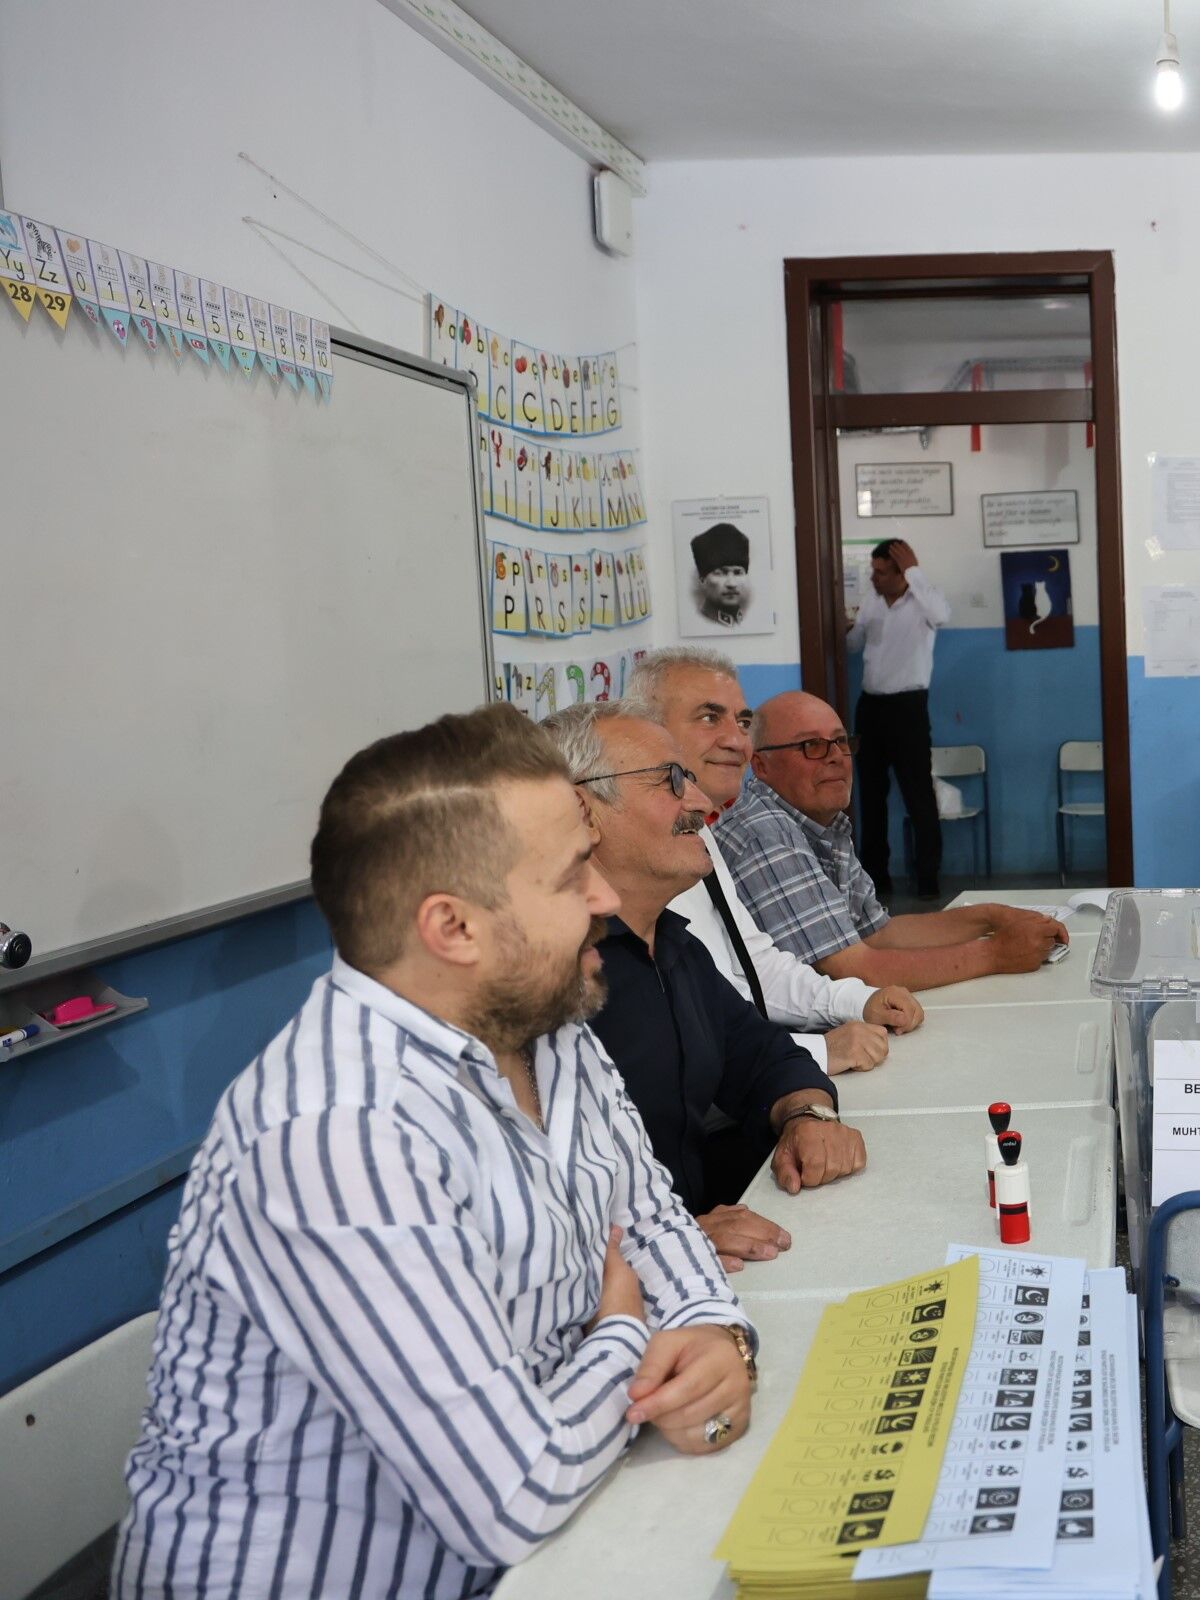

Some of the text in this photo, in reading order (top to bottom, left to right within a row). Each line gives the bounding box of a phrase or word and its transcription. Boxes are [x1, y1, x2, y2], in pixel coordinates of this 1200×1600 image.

[9, 282, 66, 312] 28 29
[36, 258, 58, 283] Zz
[108, 281, 116, 301] 1
[136, 290, 146, 310] 2
[160, 299, 170, 318] 3
[186, 308, 195, 326] 4
[211, 315, 221, 334] 5
[236, 324, 244, 341] 6
[258, 331, 266, 347] 7
[280, 338, 287, 355] 8
[299, 345, 306, 361] 9
[317, 351, 328, 368] 10
[476, 325, 485, 354] b
[573, 368, 579, 383] e
[496, 385, 617, 433] C Ç D E F G
[550, 495, 560, 527] J
[572, 497, 581, 527] K
[589, 496, 597, 527] L
[607, 498, 625, 526] M
[628, 492, 642, 520] N
[512, 562, 521, 586] p
[537, 564, 543, 578] r
[562, 569, 567, 583] s
[606, 561, 611, 578] t
[505, 595, 515, 629] P
[535, 597, 546, 630] R
[558, 601, 566, 633] S
[600, 594, 609, 624] T
[624, 591, 635, 621] U
[636, 580, 648, 616] Ü
[526, 676, 532, 690] z
[1012, 1331, 1020, 1342] CHP
[903, 1352, 912, 1363] CHP
